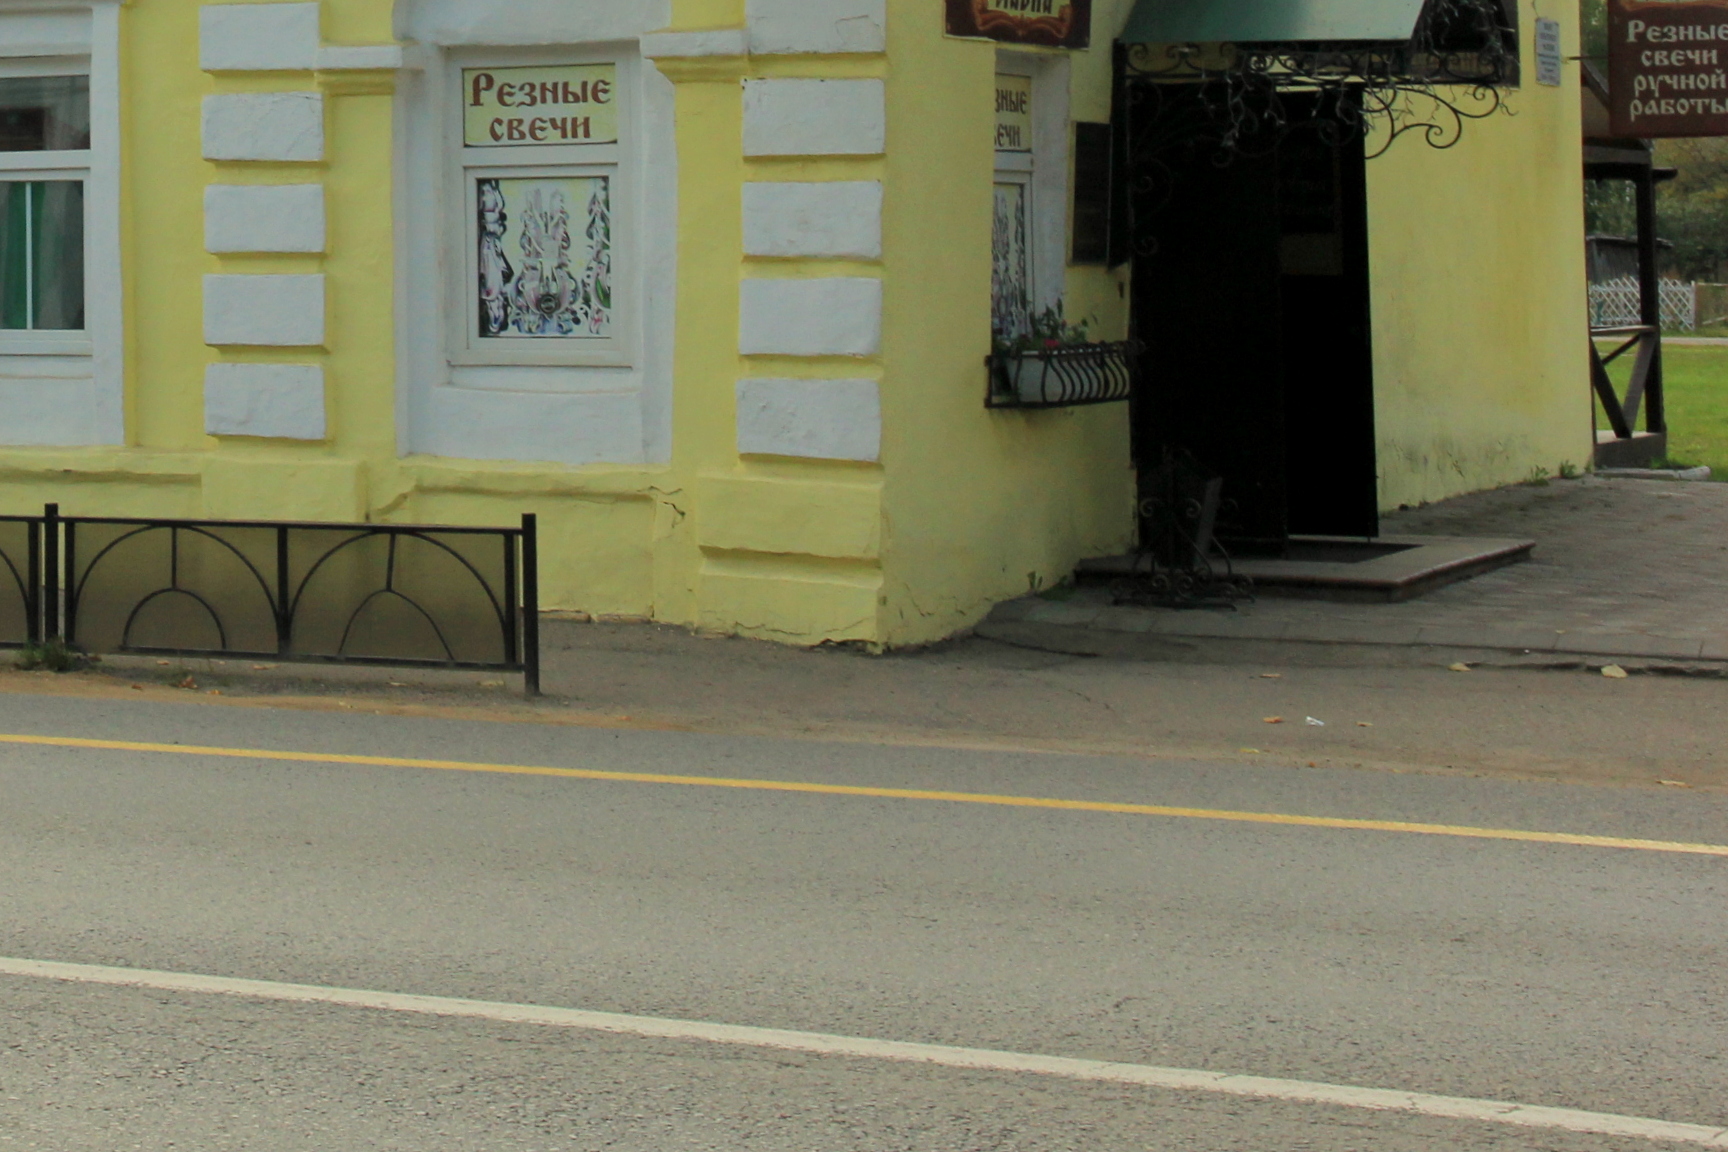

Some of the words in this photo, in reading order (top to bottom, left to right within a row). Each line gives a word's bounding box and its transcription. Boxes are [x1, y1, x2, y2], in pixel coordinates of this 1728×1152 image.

[1641, 49, 1718, 67] свечи
[469, 73, 612, 108] Резные
[1633, 68, 1727, 98] ручной
[489, 116, 591, 142] свечи
